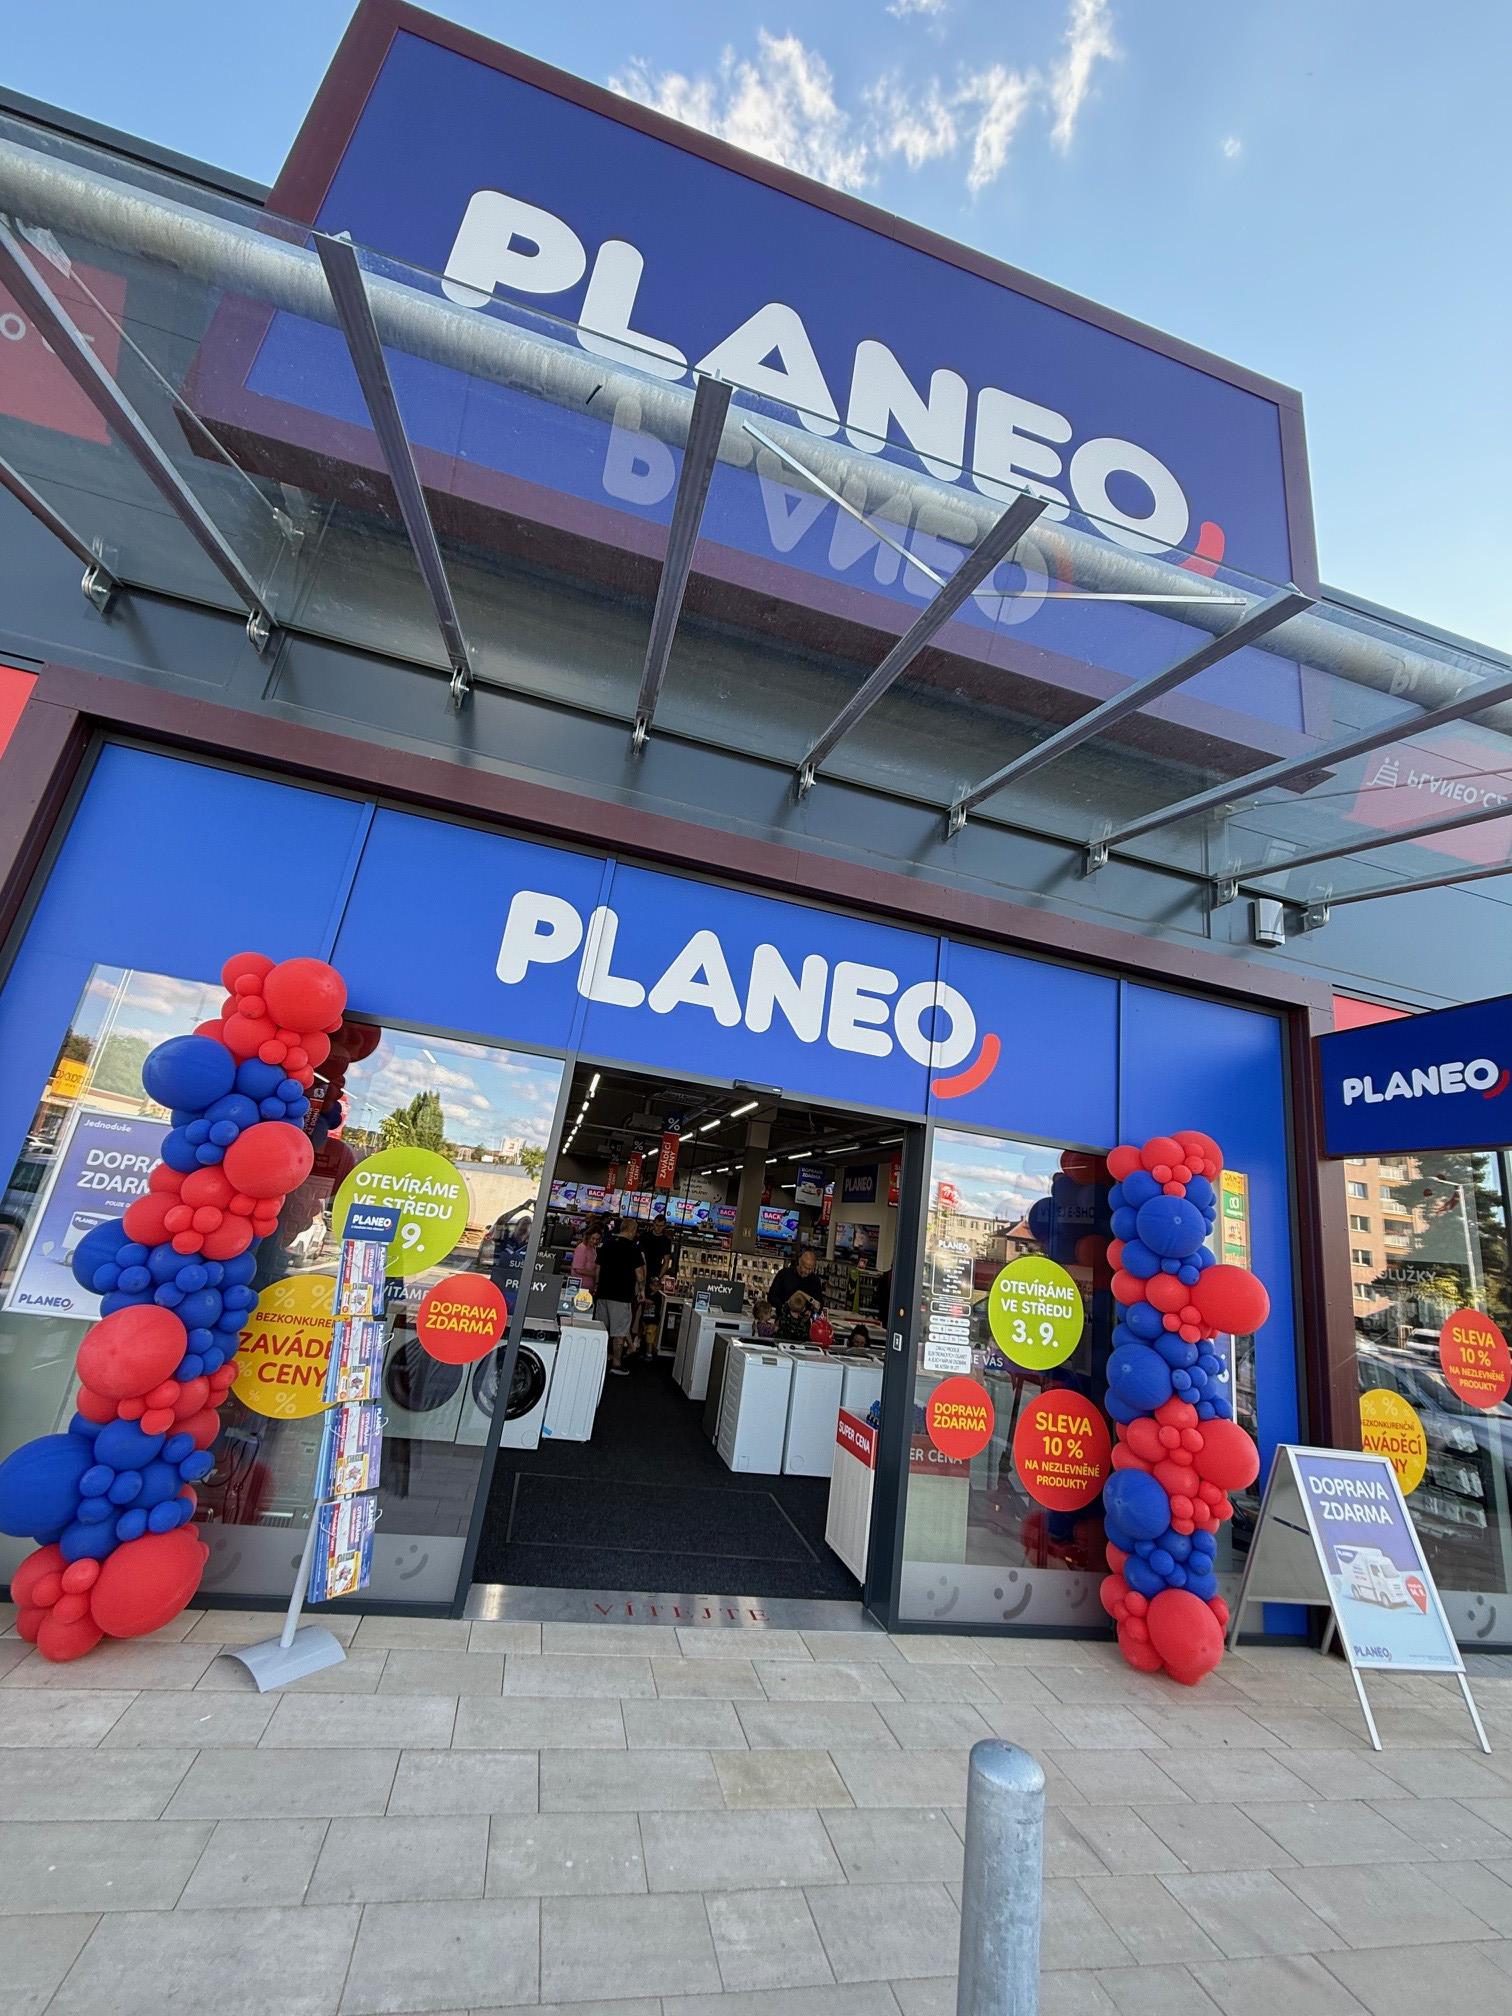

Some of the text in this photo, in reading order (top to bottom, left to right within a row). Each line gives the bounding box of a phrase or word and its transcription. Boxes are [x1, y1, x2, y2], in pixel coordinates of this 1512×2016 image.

[441, 190, 1190, 554] PLANEO
[496, 890, 976, 1069] PLANEO
[1343, 1058, 1498, 1106] PLANEO
[84, 1118, 132, 1132] Jednoduše
[86, 1150, 162, 1173] DOPRA
[78, 1171, 150, 1194] ZDARM
[356, 1170, 459, 1198] OTEVÍRÁME
[846, 1176, 872, 1192] PLANEO
[382, 1196, 452, 1220] STŘEDU
[352, 1214, 392, 1228] PLANEO
[938, 1240, 970, 1253] PLANEO
[707, 1284, 732, 1294] MYČKY
[1000, 1279, 1074, 1300] OTEVÍRÁME
[18, 1294, 70, 1308] PLANEO
[429, 1301, 498, 1320] DOPRAVA
[1001, 1298, 1072, 1319] VE STŘEDU
[256, 1312, 332, 1328] BEZKONKURE
[426, 1315, 494, 1336] ZDARMA
[1012, 1320, 1058, 1348] 3. 9.
[1452, 1327, 1495, 1348] SLEVA
[238, 1332, 330, 1359] ZAVÁD
[983, 1351, 1003, 1367] VÁS
[1460, 1348, 1491, 1366] 10 %
[258, 1362, 328, 1387] CENY
[1450, 1366, 1505, 1382] NA NEZLEVNĚNÉ
[1459, 1379, 1497, 1392] PRODUKTY
[934, 1402, 987, 1418] DOPRAVA
[933, 1415, 986, 1431] ZDARMA
[1035, 1412, 1092, 1436] SLEVA
[1362, 1418, 1414, 1432] EZKONKURENČNÍ
[838, 1421, 870, 1454] SUPER CENA
[1042, 1436, 1084, 1459] 10 %
[1362, 1432, 1423, 1455] AVÁDĚCÍ
[1024, 1459, 1100, 1478] NA NEZLEVNĚNÉ
[1394, 1460, 1408, 1474] NY
[1036, 1475, 1087, 1490] PRODUKTY
[1309, 1476, 1389, 1500] DOPRAVA
[1320, 1501, 1393, 1525] ZDARMA
[1354, 1646, 1389, 1658] PLANEO
